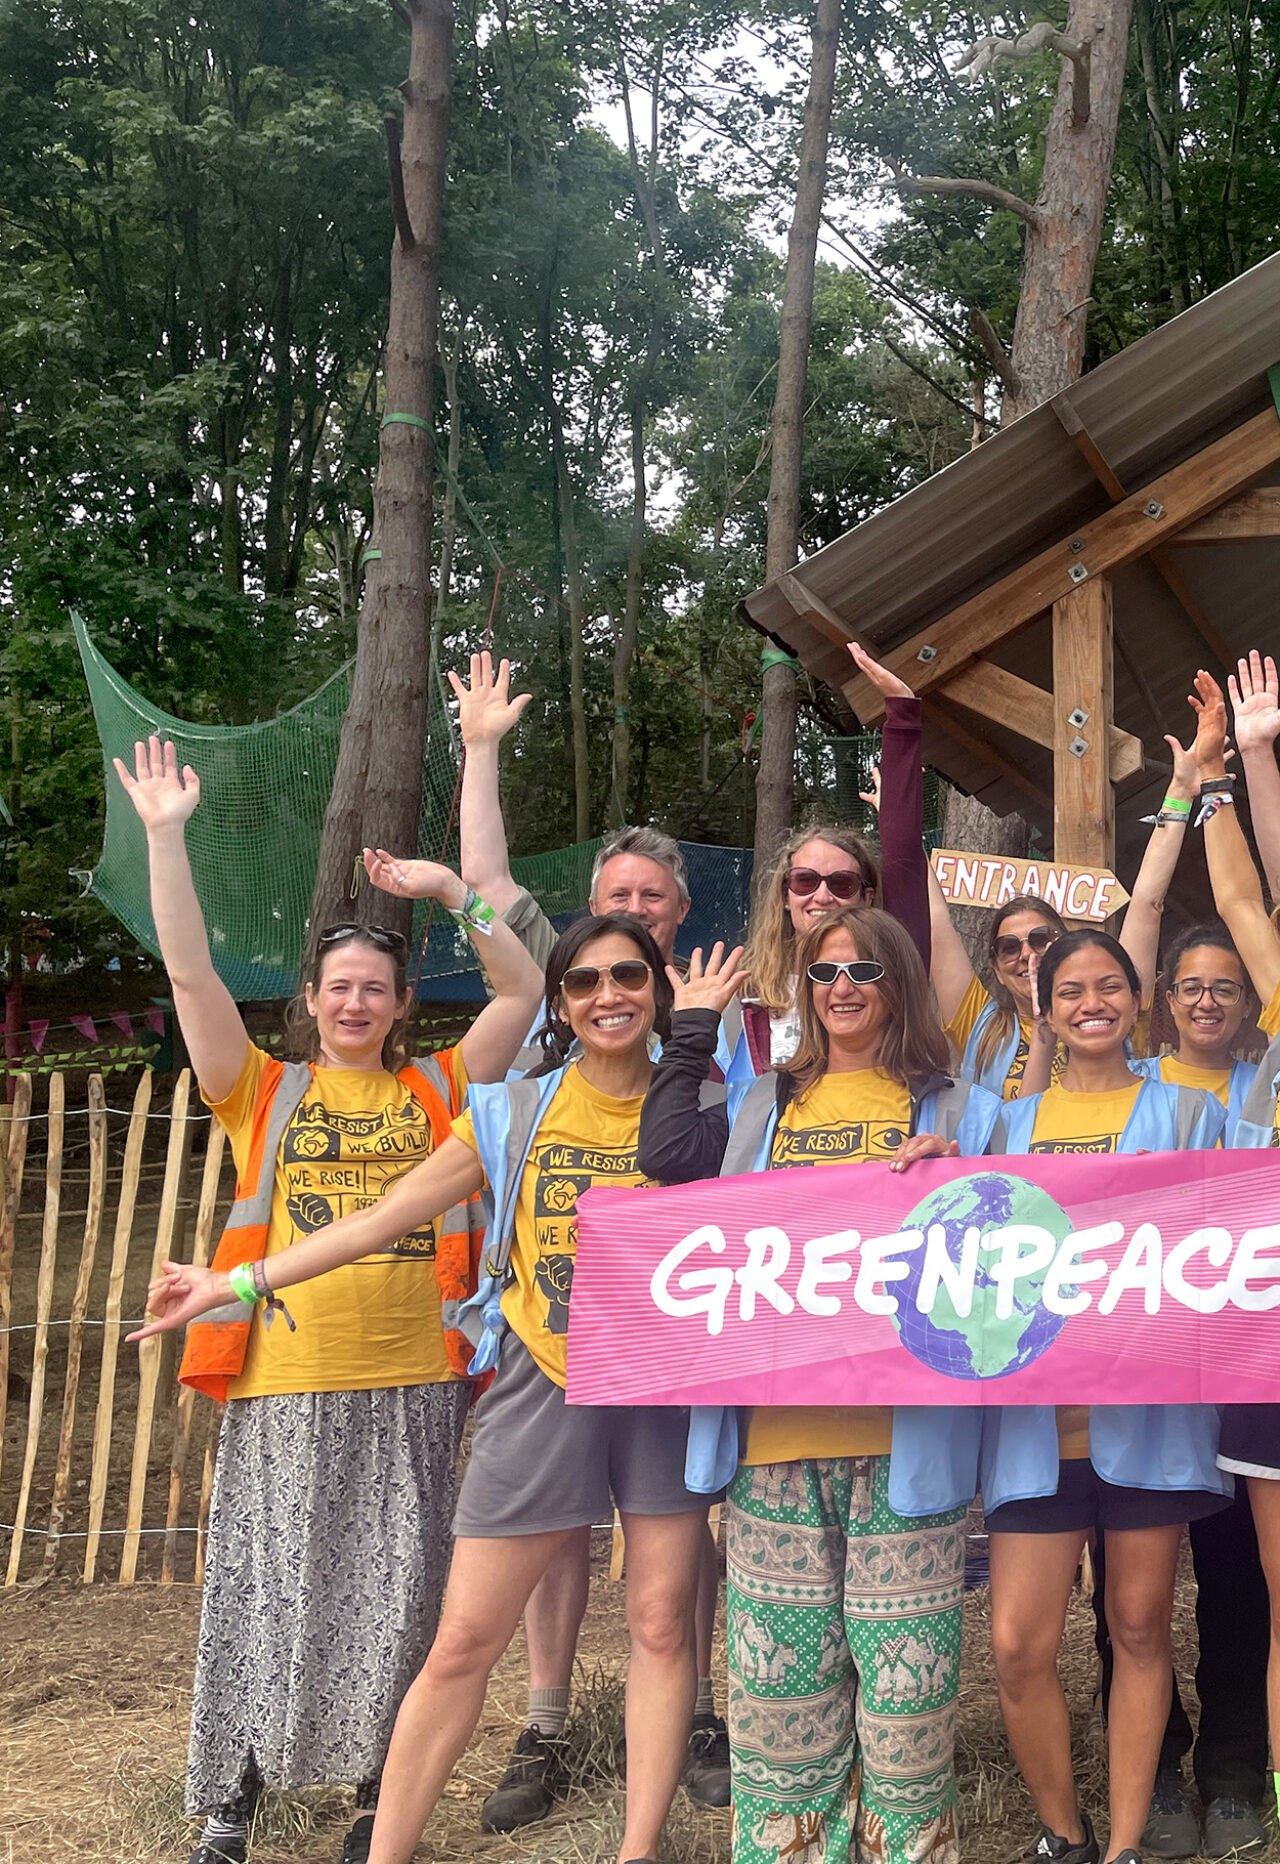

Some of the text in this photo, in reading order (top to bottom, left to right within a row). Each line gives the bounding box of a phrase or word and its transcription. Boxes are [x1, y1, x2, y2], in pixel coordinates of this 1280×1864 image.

[935, 856, 1117, 919] ENTRANCE
[347, 1142, 373, 1153] WE
[549, 1147, 575, 1167] WE
[288, 1171, 313, 1188] WE
[354, 1197, 378, 1210] 197
[538, 1224, 559, 1246] WE
